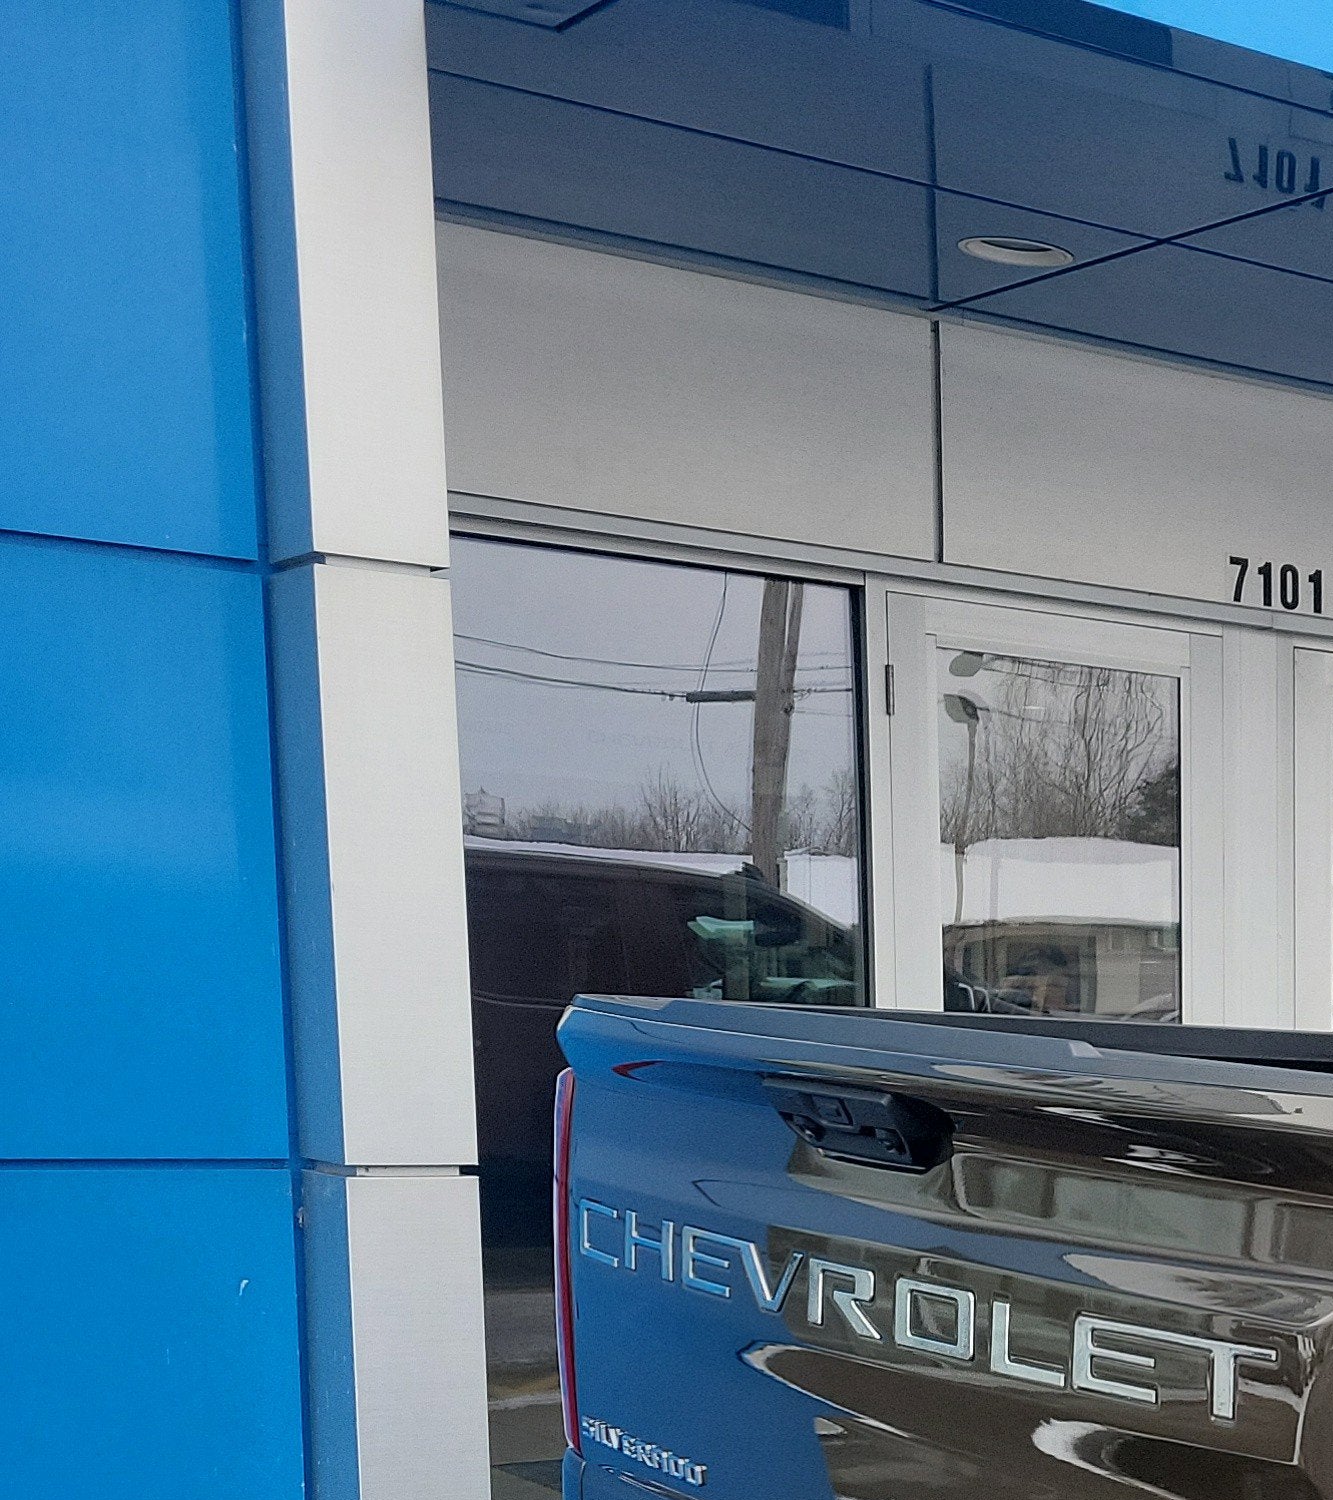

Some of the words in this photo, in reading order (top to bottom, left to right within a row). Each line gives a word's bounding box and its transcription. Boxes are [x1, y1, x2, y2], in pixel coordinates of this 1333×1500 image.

[1228, 555, 1322, 614] 7101
[579, 1199, 1278, 1420] CHEVROLET
[582, 1415, 707, 1486] SILVERADO
